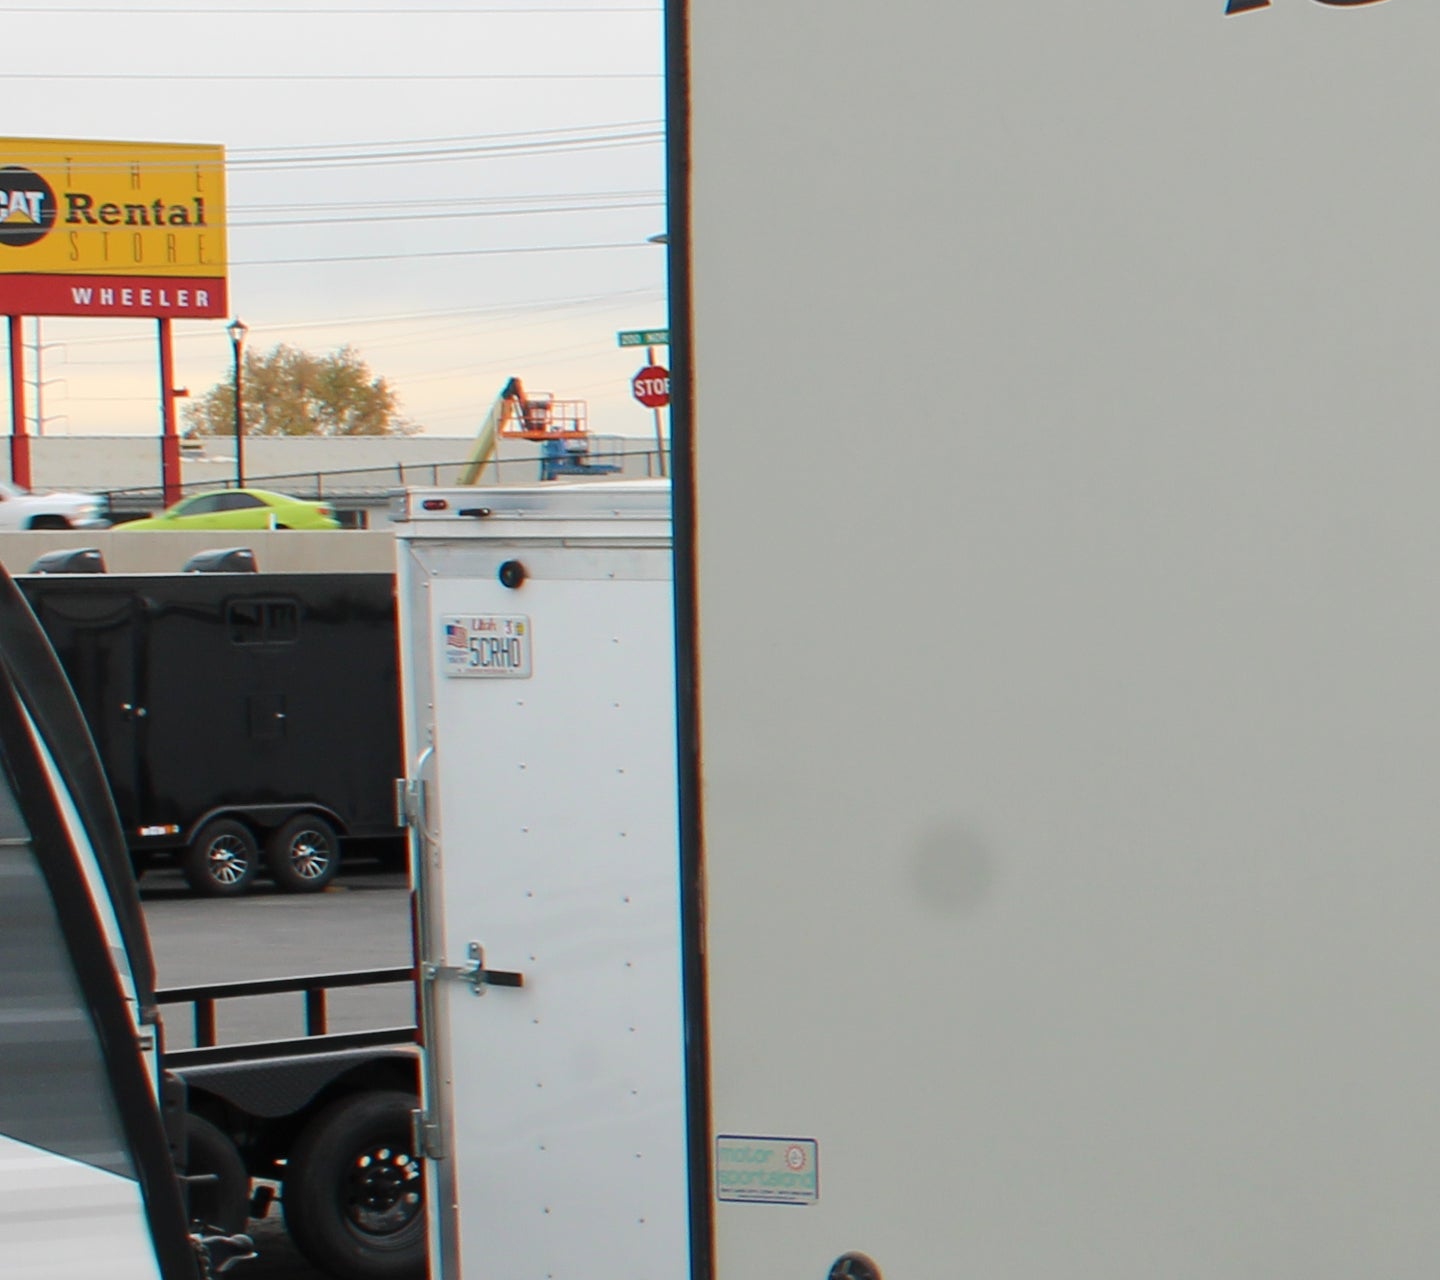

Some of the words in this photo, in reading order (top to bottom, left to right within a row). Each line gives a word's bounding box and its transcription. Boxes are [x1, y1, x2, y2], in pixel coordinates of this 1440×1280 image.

[63, 157, 204, 192] THE
[63, 192, 208, 227] Rental
[69, 231, 205, 264] STORE
[71, 287, 209, 308] WHEELER
